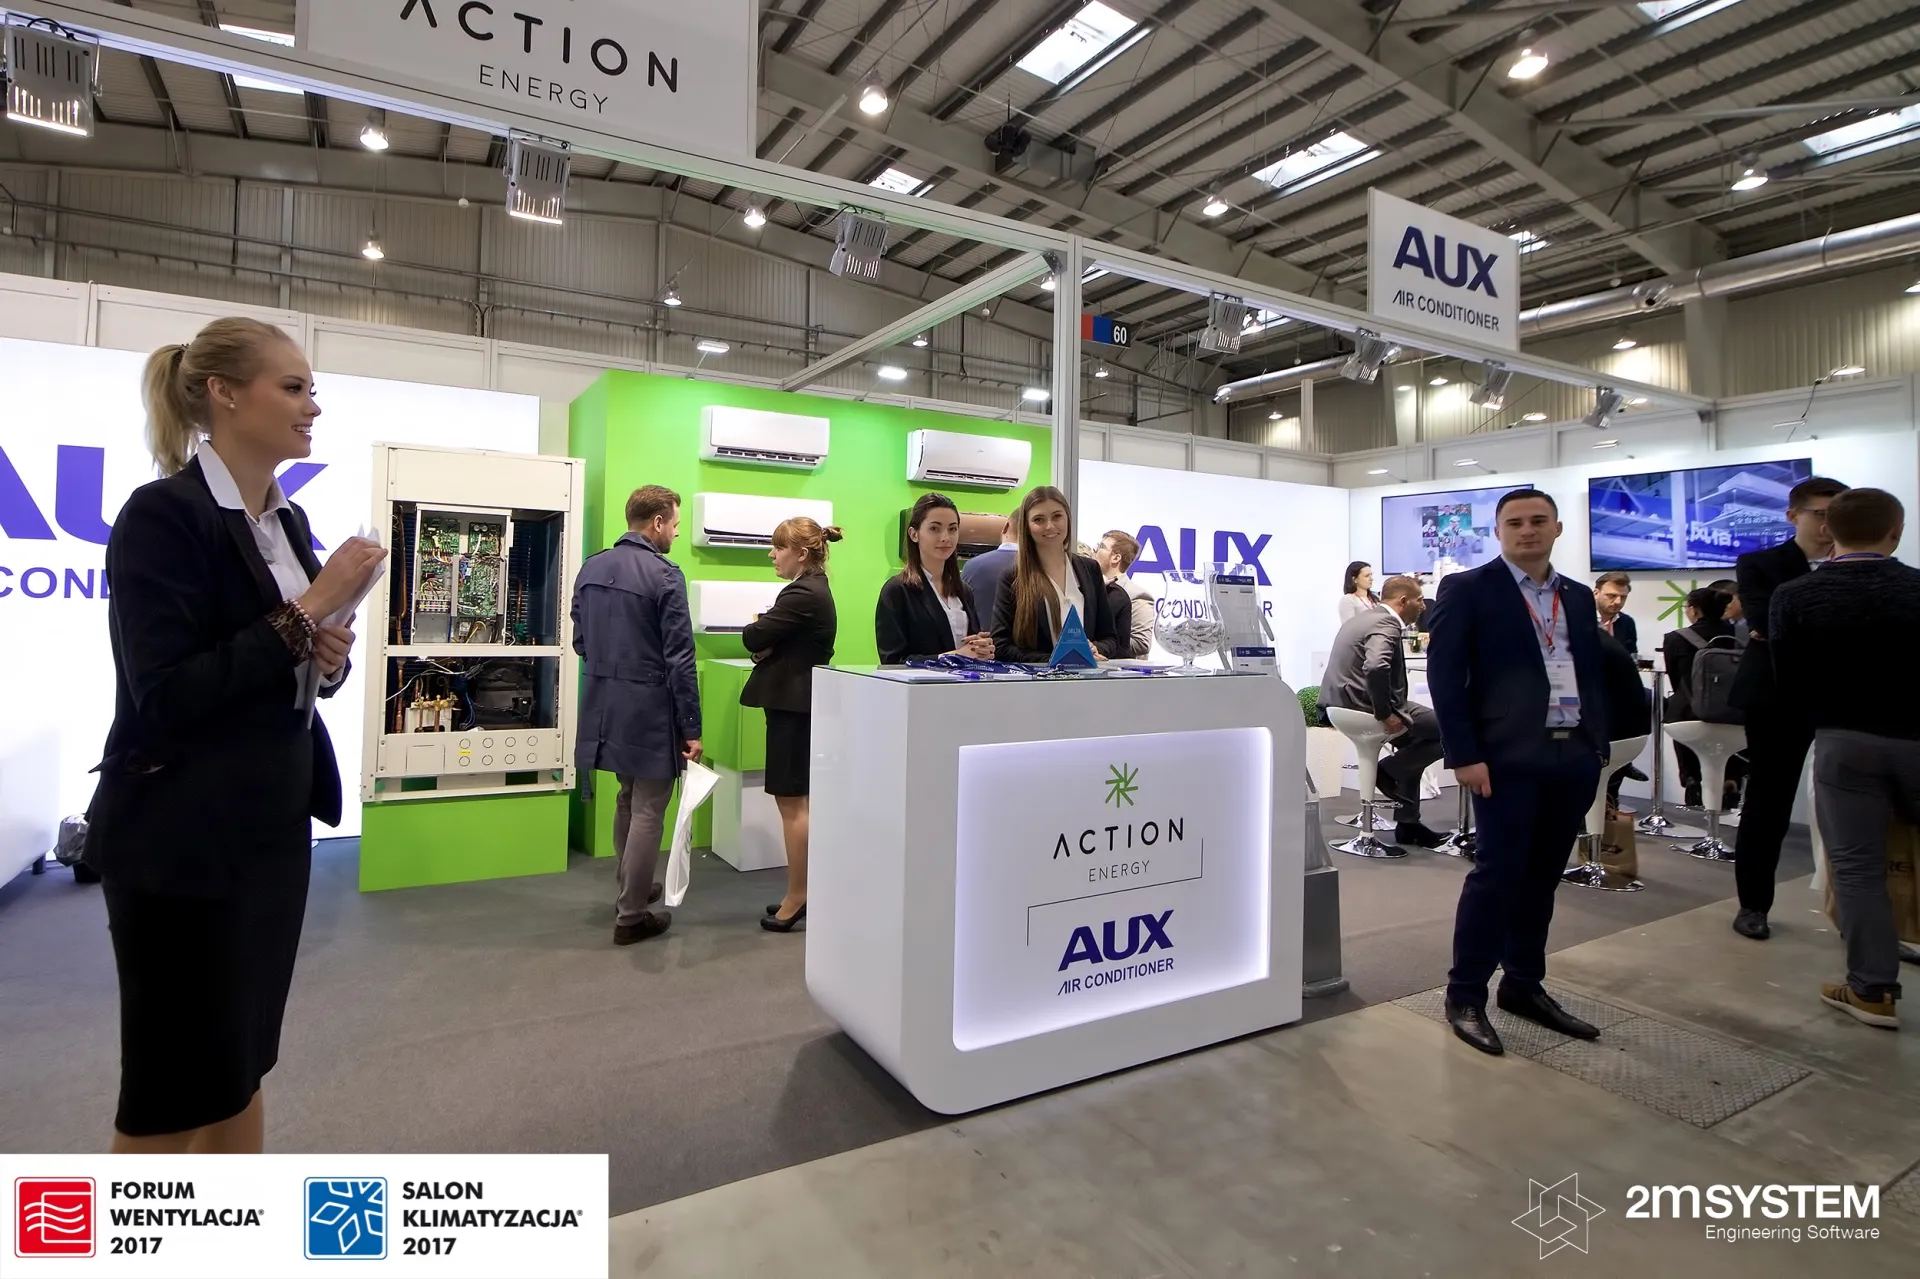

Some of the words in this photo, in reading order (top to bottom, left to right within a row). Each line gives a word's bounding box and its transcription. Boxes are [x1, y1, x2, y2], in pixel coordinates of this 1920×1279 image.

[400, 0, 678, 93] ACTION
[480, 64, 608, 113] ENERGY
[1393, 226, 1499, 298] AUX
[1392, 289, 1415, 309] AIR
[1417, 295, 1500, 332] CONDITIONER
[1113, 325, 1127, 344] 60
[1126, 525, 1273, 587] AUX
[1053, 817, 1184, 860] ACTION
[1088, 860, 1150, 882] ENERGY
[1058, 909, 1175, 972] AUX
[1057, 978, 1082, 996] AIR
[1084, 957, 1175, 989] CONDITIONER
